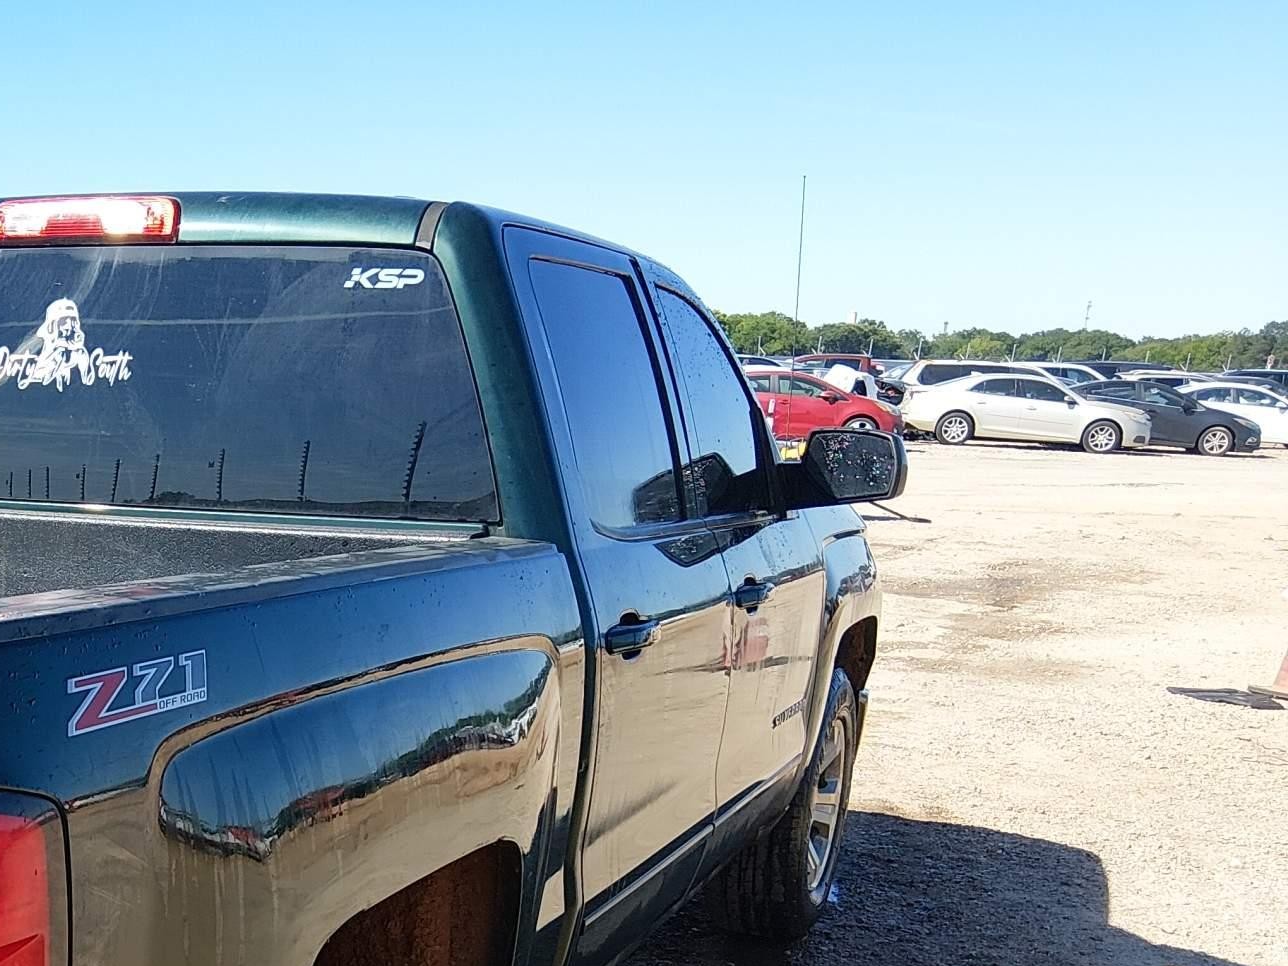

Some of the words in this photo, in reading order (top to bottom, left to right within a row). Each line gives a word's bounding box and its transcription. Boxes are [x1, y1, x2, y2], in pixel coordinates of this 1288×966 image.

[343, 267, 425, 289] KSP
[86, 347, 133, 387] South
[67, 648, 208, 738] Z71
[158, 697, 177, 710] OFF
[179, 689, 206, 704] ROAD
